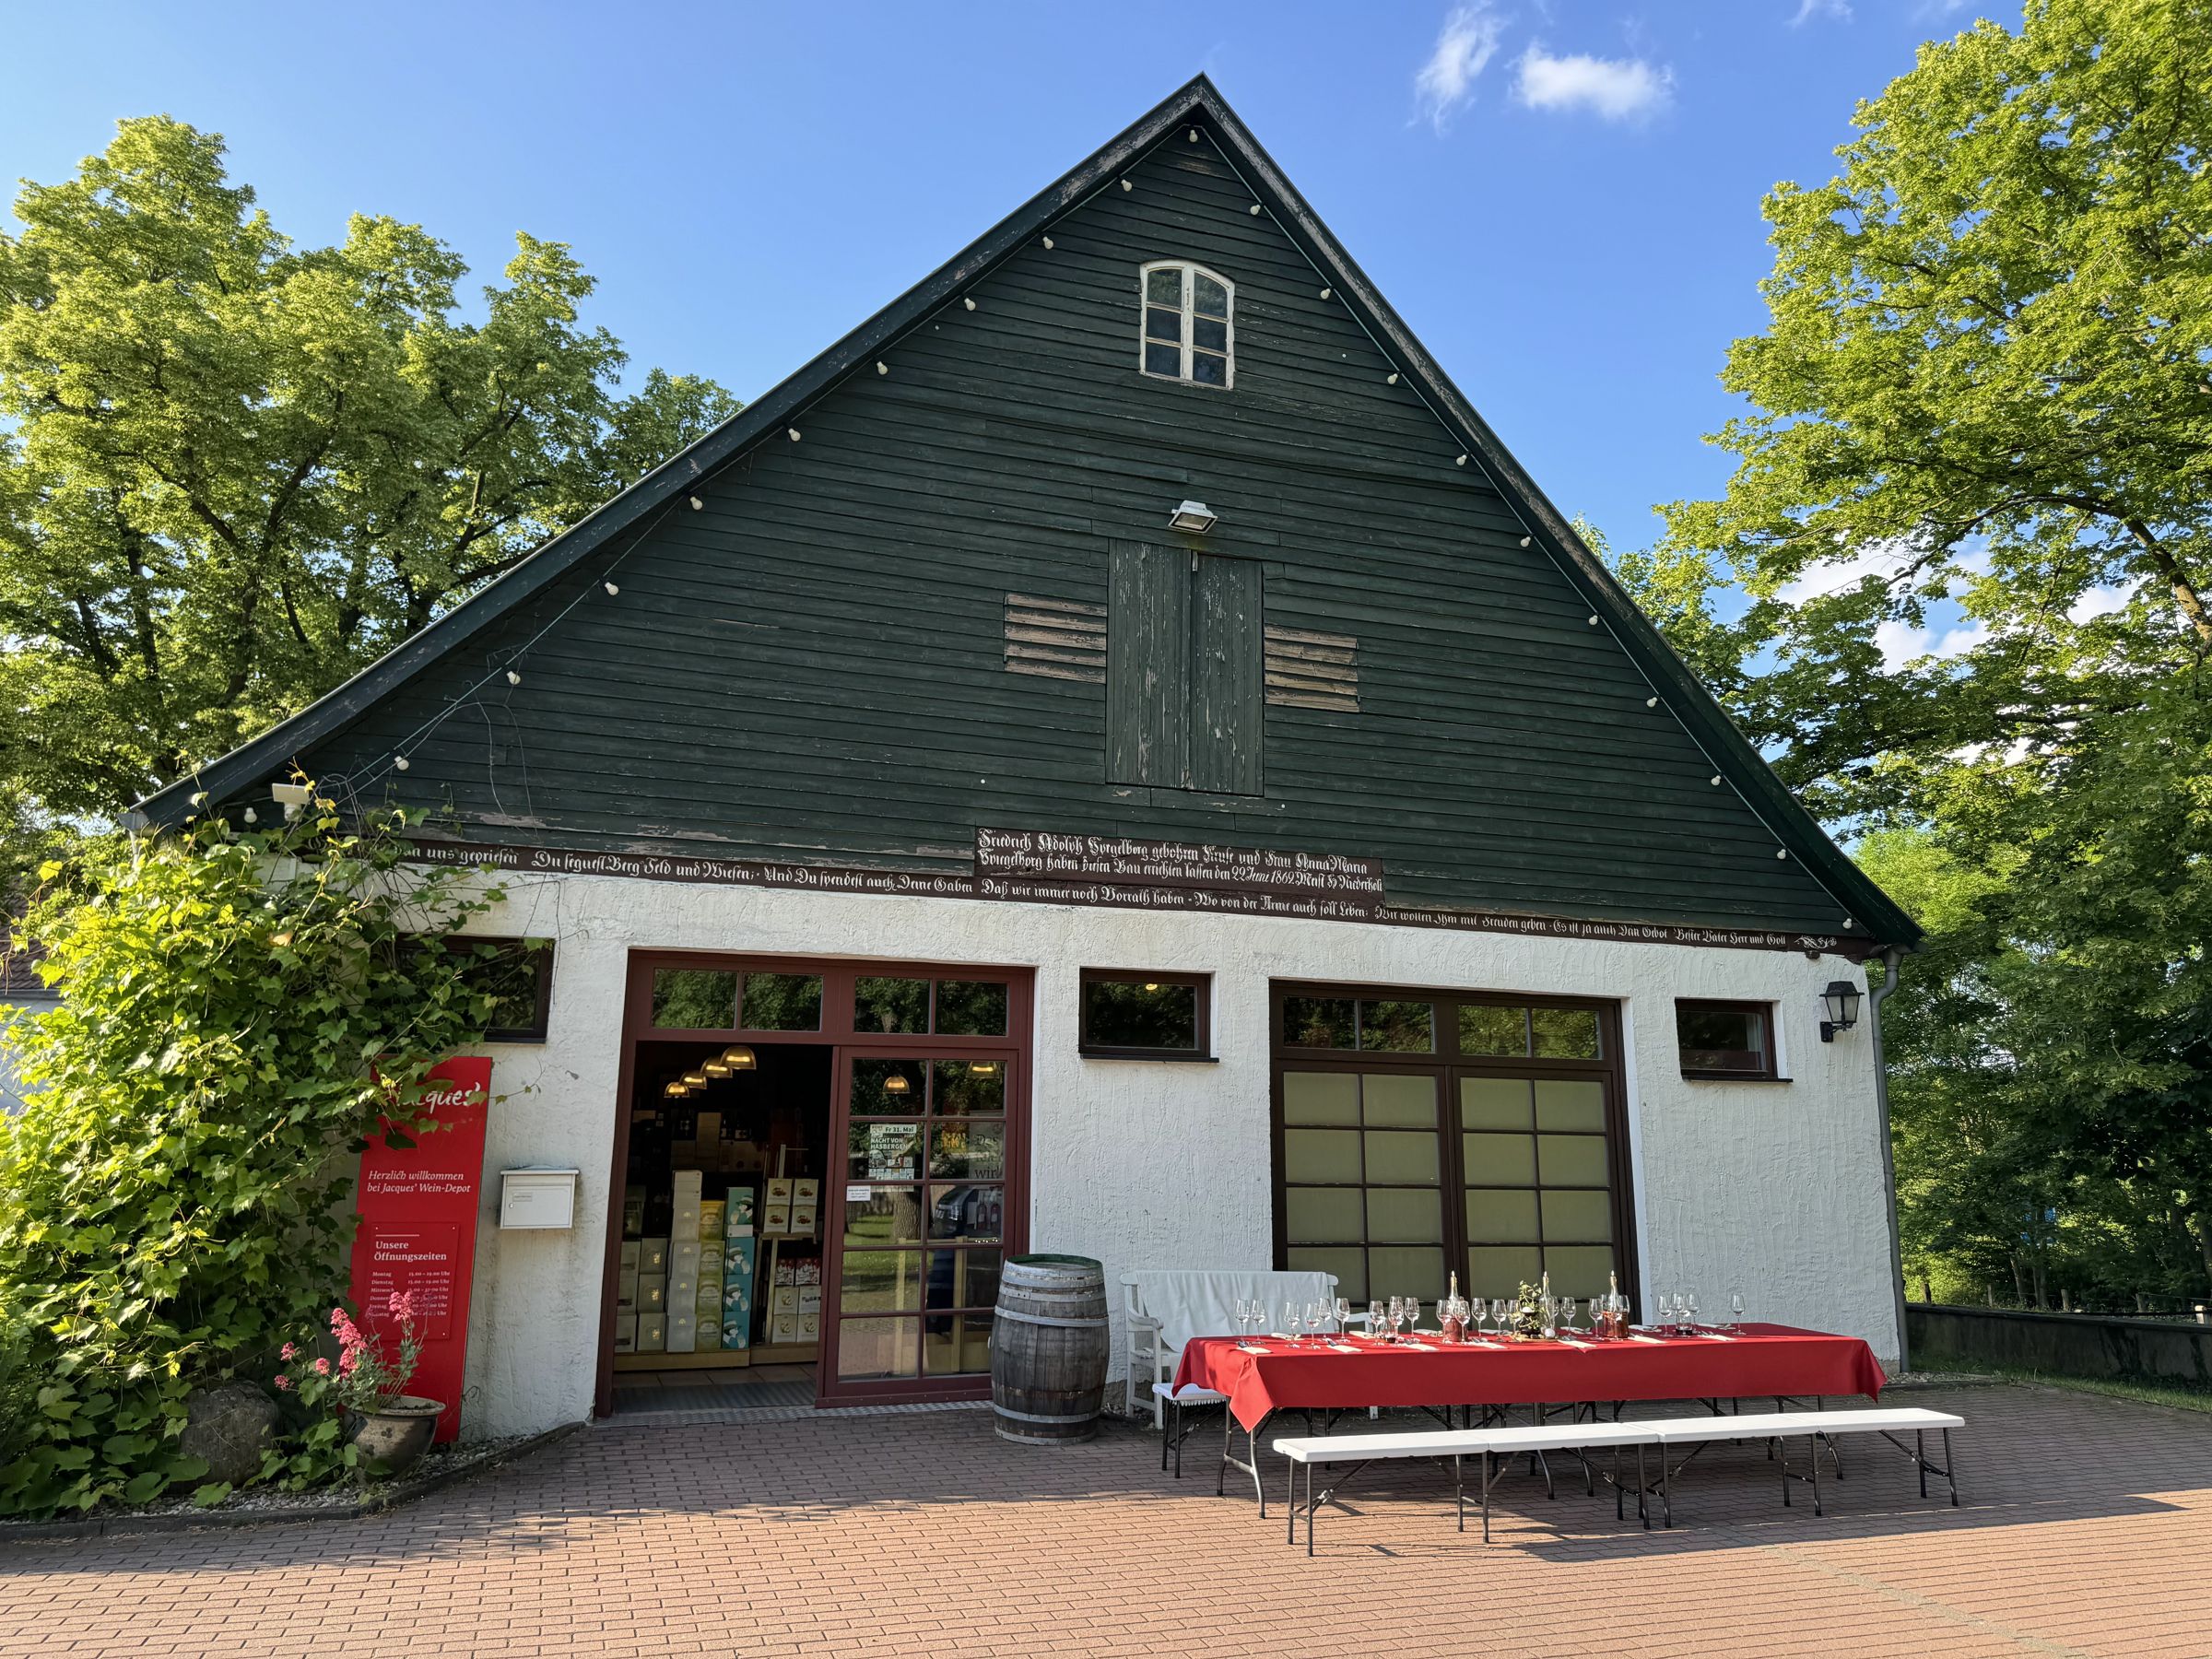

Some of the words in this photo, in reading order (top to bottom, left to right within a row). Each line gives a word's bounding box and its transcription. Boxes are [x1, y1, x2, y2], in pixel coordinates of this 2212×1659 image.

[978, 827, 1032, 852] Friedrich
[1037, 832, 1083, 855] Adolph
[1150, 841, 1199, 863] gebohren
[1239, 848, 1261, 865] und
[1265, 850, 1291, 868] Frau
[1295, 853, 1329, 872] Anna
[1328, 853, 1368, 875] Maria
[1046, 853, 1078, 872] haben
[1081, 855, 1111, 874] diesen
[1113, 857, 1142, 875] Bau
[1144, 860, 1182, 879] errichten
[1184, 862, 1213, 880] lassen
[1214, 865, 1231, 881] den
[1245, 865, 1270, 882] Juni
[427, 847, 455, 861] uns
[459, 847, 520, 865] gepriesen
[531, 850, 560, 868] Du
[564, 853, 607, 874] segnest
[605, 855, 641, 877] Berg
[642, 856, 672, 875] Feld
[676, 861, 700, 877] und
[763, 865, 793, 882] Und
[794, 867, 818, 885] Du
[819, 871, 864, 889] spendest
[866, 874, 897, 891] auch
[896, 874, 932, 891] Deine
[934, 877, 973, 893] Gaben
[1011, 883, 1031, 897] wir
[1034, 884, 1070, 900] immer
[1072, 885, 1099, 903] noch
[1152, 888, 1185, 907] haben
[1194, 891, 1218, 907] Wo
[1220, 897, 1241, 909] von
[1243, 896, 1258, 910] der
[1260, 894, 1290, 912] Arme
[1292, 899, 1317, 917] auch
[1320, 900, 1338, 917] soll
[1374, 904, 1398, 920] Wir
[1400, 911, 1432, 923] wollen
[1433, 912, 1457, 926] Ihm
[1460, 914, 1478, 926] mit
[1481, 915, 1519, 930] Freuden
[1521, 919, 1547, 933] geben
[1553, 919, 1568, 933] Es
[1569, 922, 1579, 935] ist
[1581, 924, 1592, 937] ja
[1594, 924, 1617, 936] auch
[1641, 926, 1668, 939] Gebot
[1673, 927, 1701, 942] Bester
[1702, 929, 1728, 943] Vater
[1729, 931, 1748, 945] Herr
[1749, 933, 1765, 945] und
[1766, 932, 1786, 946] Gott
[369, 1170, 406, 1181] Herzlich
[408, 1170, 465, 1181] willkommen
[367, 1182, 381, 1192] bei
[418, 1182, 471, 1194] Wein-Depot
[375, 1241, 409, 1250] Unsere
[373, 1251, 447, 1263] Öffnungszeiten
